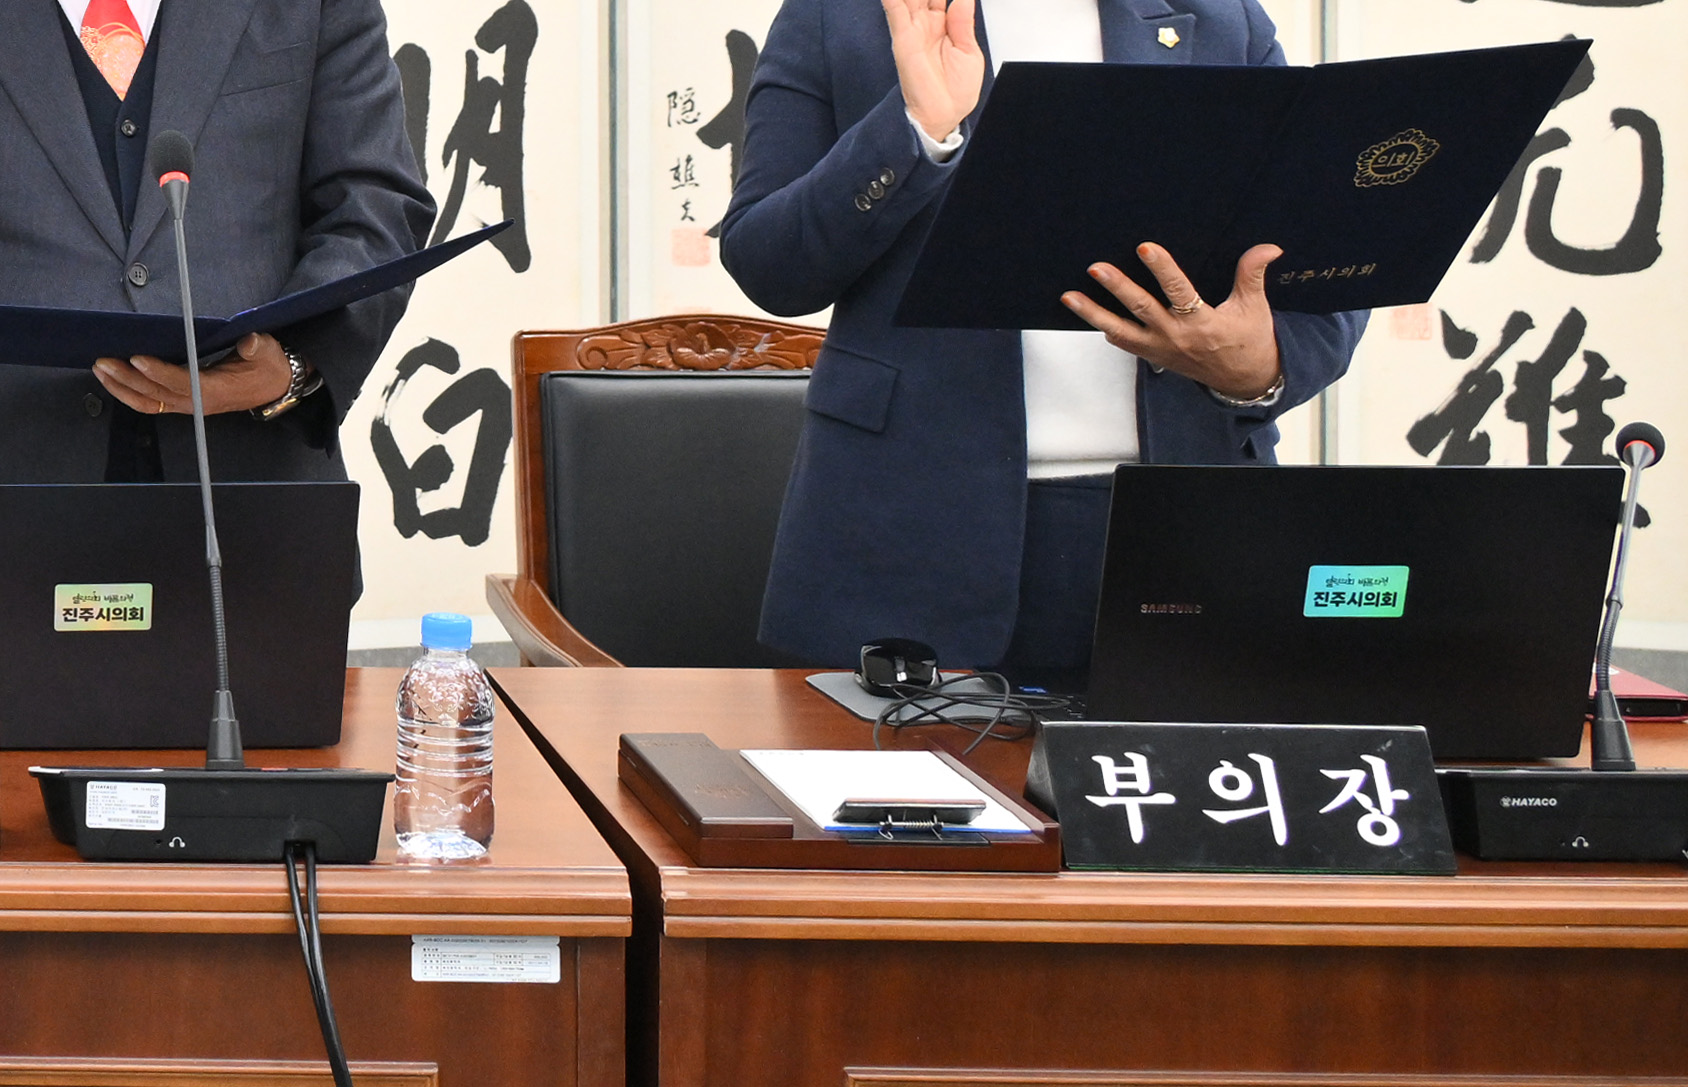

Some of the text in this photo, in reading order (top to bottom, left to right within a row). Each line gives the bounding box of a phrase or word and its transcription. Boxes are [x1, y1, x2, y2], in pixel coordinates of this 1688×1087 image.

[1278, 263, 1377, 284] 진주시의회
[1313, 591, 1398, 608] 진주시의회
[62, 606, 145, 623] 진주시의회
[1139, 603, 1203, 614] SAMSUNG
[1084, 751, 1410, 847] 부의장
[1511, 797, 1558, 807] HAYACO
